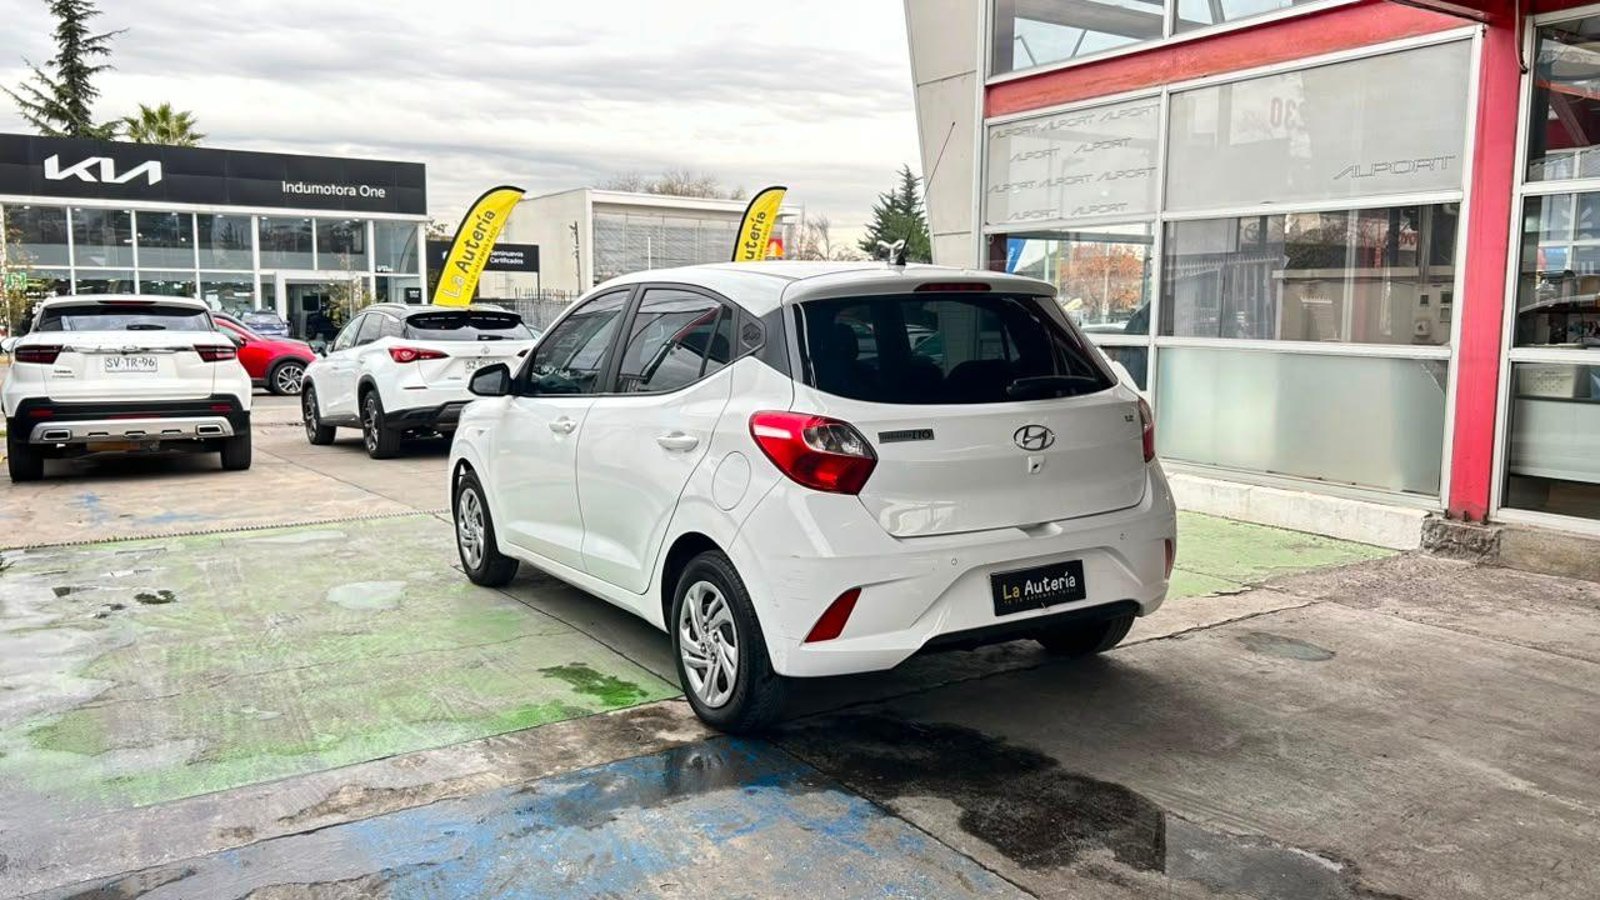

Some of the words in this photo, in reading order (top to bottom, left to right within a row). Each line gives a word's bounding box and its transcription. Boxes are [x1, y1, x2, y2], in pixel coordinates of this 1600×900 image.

[44, 154, 162, 185] KIA
[1333, 155, 1456, 180] ALPORT
[282, 180, 357, 196] Indumotora
[359, 184, 386, 198] One
[745, 211, 766, 260] utería
[442, 275, 465, 299] La
[455, 209, 495, 274] Autería
[1003, 584, 1020, 600] La
[1024, 571, 1076, 596] Autería
